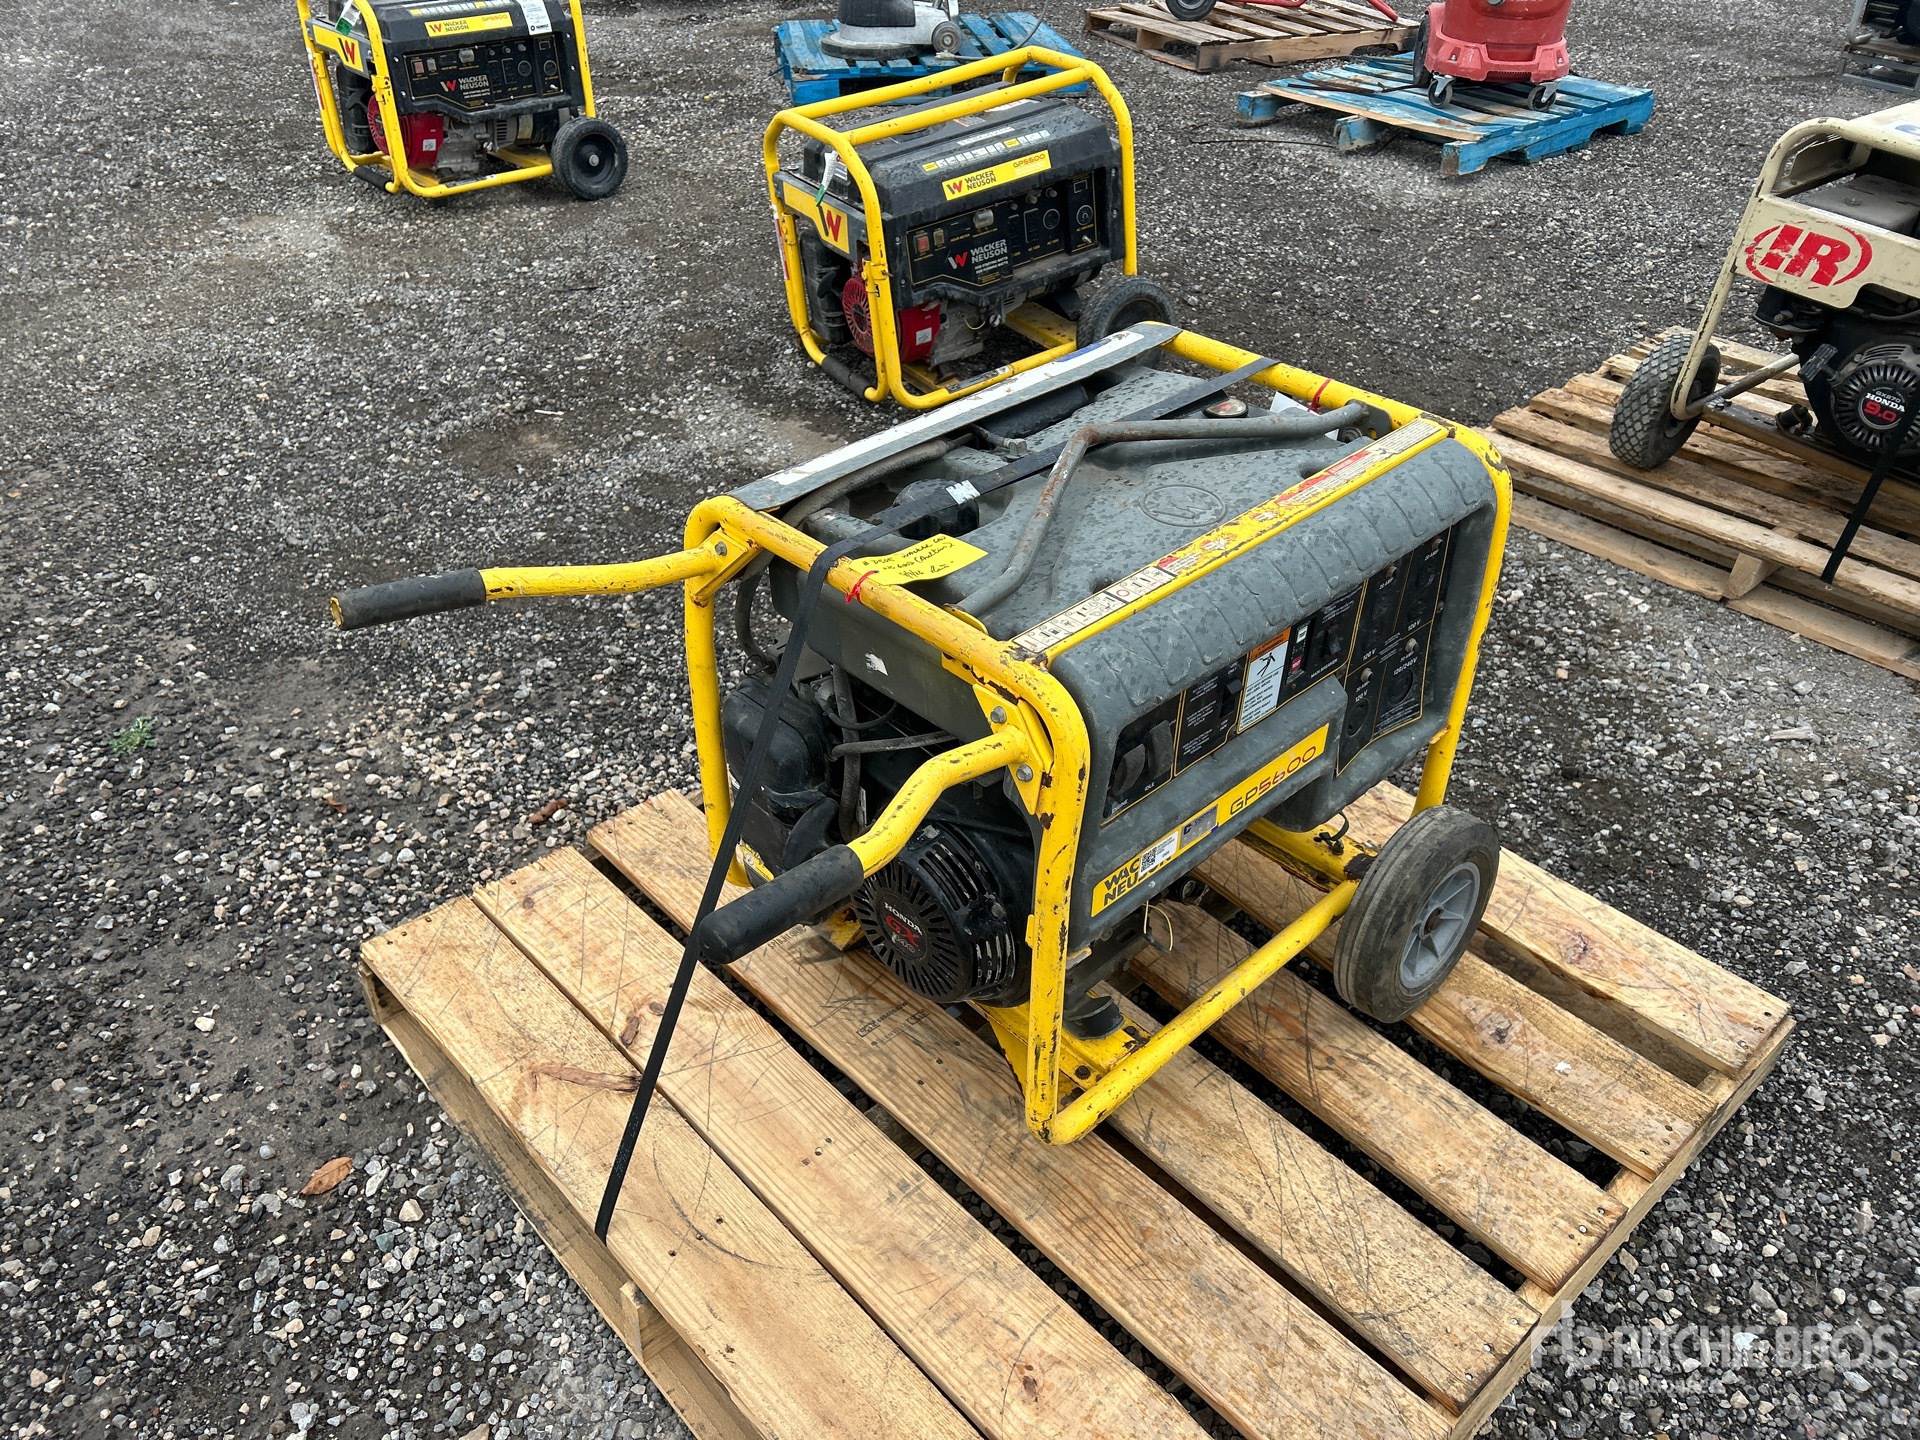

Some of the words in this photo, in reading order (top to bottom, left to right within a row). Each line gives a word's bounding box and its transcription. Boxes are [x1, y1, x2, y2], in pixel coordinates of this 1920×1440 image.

[458, 74, 488, 84] WACKER
[460, 80, 490, 90] NEUSON
[964, 170, 995, 184] WACKER
[966, 176, 997, 190] NEUSON
[970, 239, 1006, 256] WACKER
[971, 246, 1008, 264] NEUSON
[1864, 400, 1897, 422] 9.0
[1865, 392, 1906, 412] HONDA
[1230, 746, 1317, 816] GP5600
[1104, 857, 1140, 890] WAC
[884, 901, 922, 936] HONDA
[886, 915, 920, 948] GX
